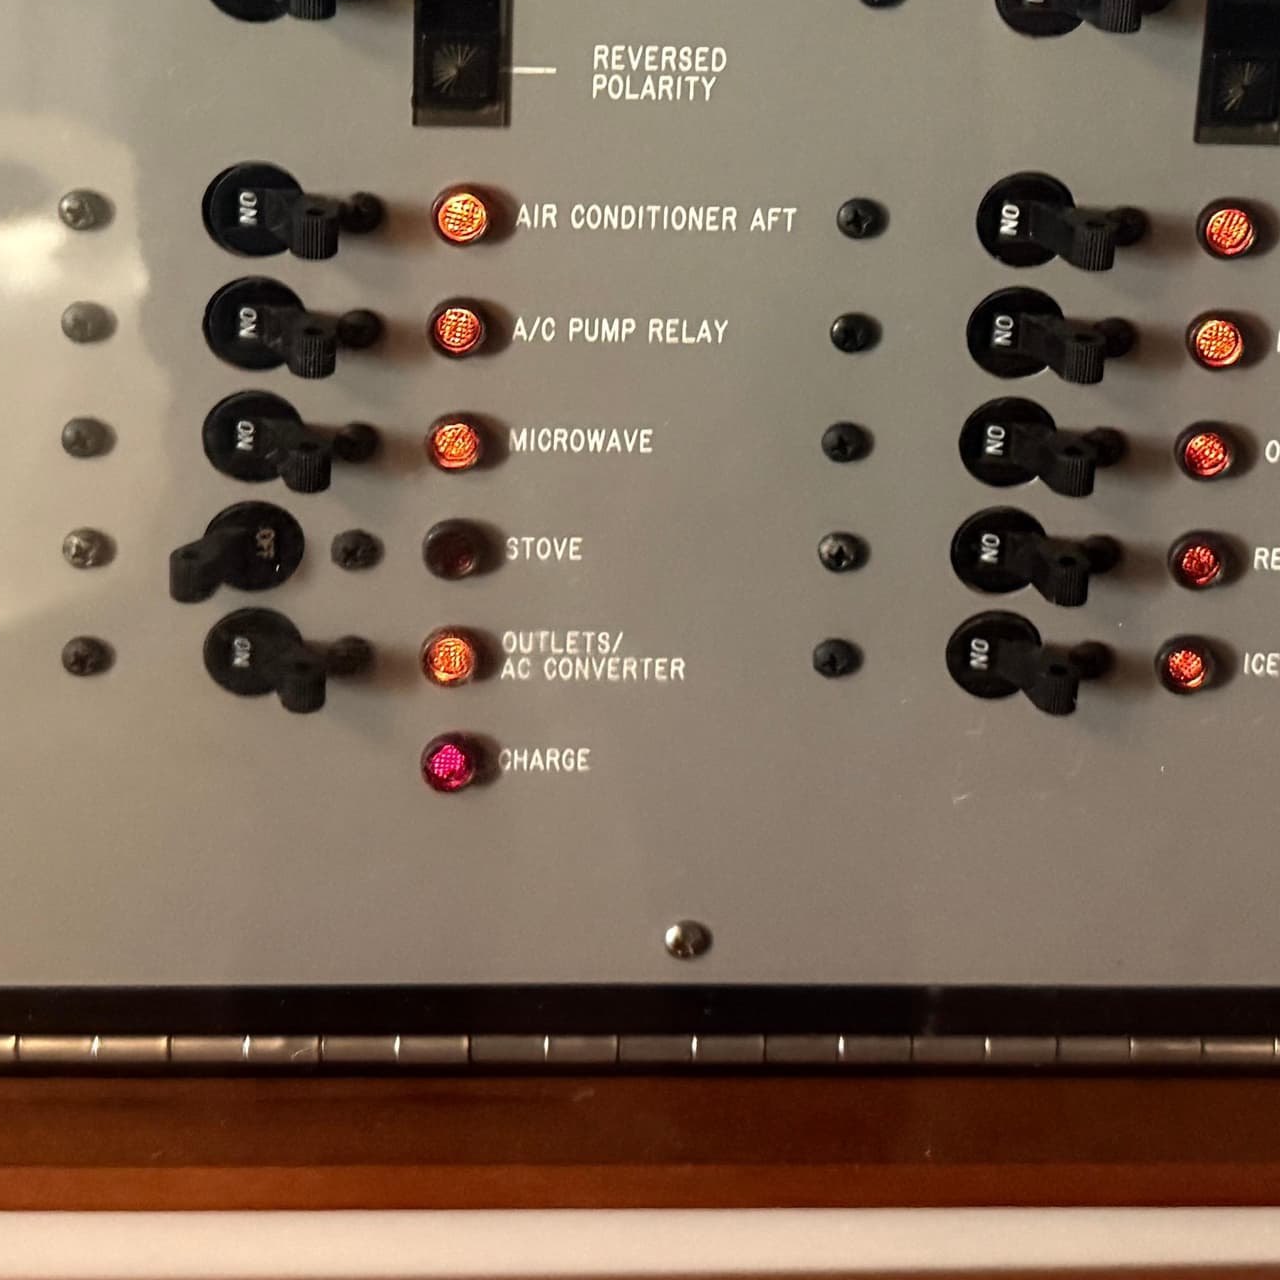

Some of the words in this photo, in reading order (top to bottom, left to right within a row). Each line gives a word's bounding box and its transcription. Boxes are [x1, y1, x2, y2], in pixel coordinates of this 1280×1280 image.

[592, 44, 727, 72] REVERSED
[592, 74, 718, 101] POLARITY
[239, 191, 258, 225] ON
[515, 207, 558, 229] AIR
[571, 206, 738, 231] CONDITIONER
[749, 208, 798, 232] AFT
[1000, 204, 1019, 236] ON
[239, 307, 258, 339] ON
[512, 319, 556, 343] A/C
[569, 319, 636, 343] PUMP
[648, 320, 729, 344] RELAY
[995, 315, 1014, 345] ON
[236, 420, 256, 451] ON
[508, 428, 654, 453] MICROWAVE
[986, 425, 1006, 455] ON
[506, 537, 583, 561] STOVE
[981, 533, 1000, 563] ON
[233, 637, 252, 668] ON
[502, 631, 624, 655] OUTLETS/
[970, 637, 989, 669] ON
[501, 658, 531, 680] AC
[544, 657, 686, 682] CONVERTER
[1243, 653, 1280, 675] ICE
[499, 748, 591, 772] CHARGE
